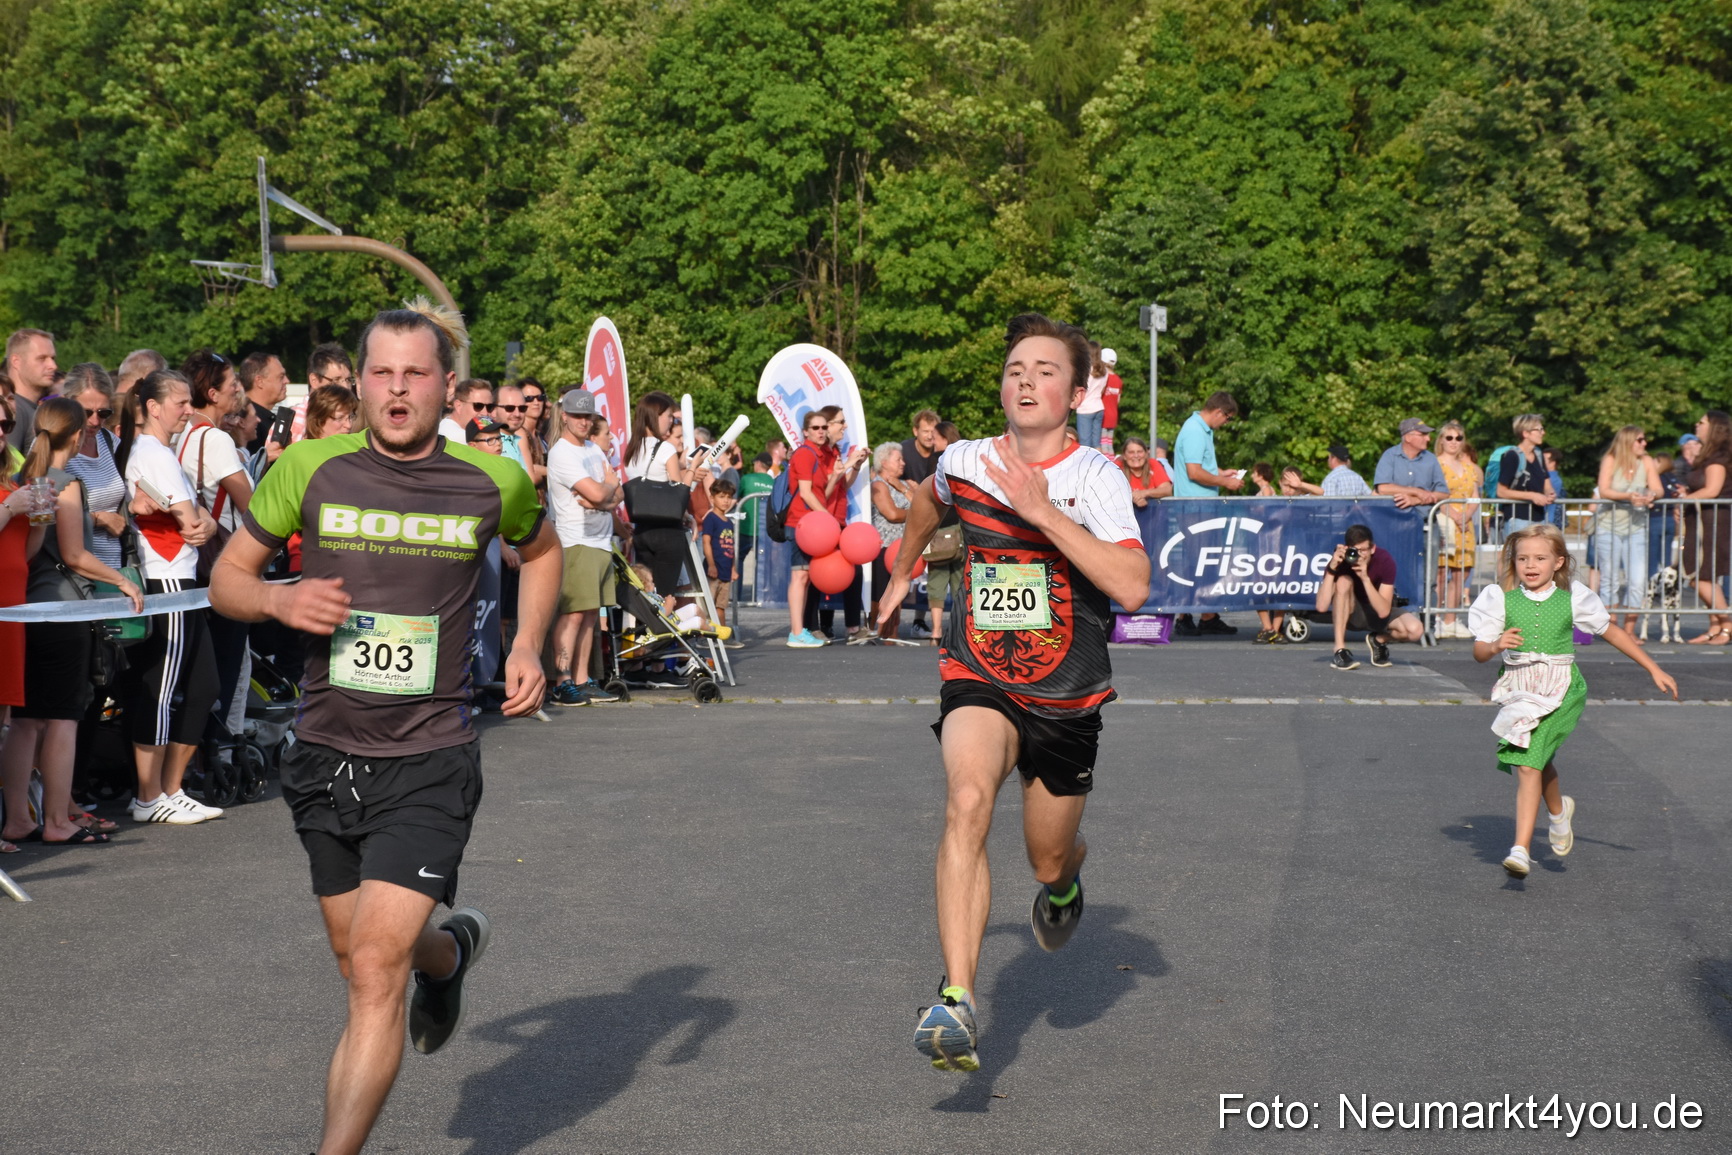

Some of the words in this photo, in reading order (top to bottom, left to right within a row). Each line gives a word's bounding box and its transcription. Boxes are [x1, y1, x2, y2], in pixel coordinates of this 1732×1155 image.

[1050, 498, 1068, 508] RKT
[320, 506, 478, 546] BOCK
[319, 538, 365, 554] inspired
[369, 543, 386, 555] by
[389, 546, 427, 557] smart
[1195, 545, 1333, 577] Fische
[1210, 582, 1321, 595] AUTOMOBI
[979, 588, 1036, 612] 2250
[353, 641, 414, 673] 303
[354, 669, 382, 679] Hörner
[384, 672, 411, 681] Arthur
